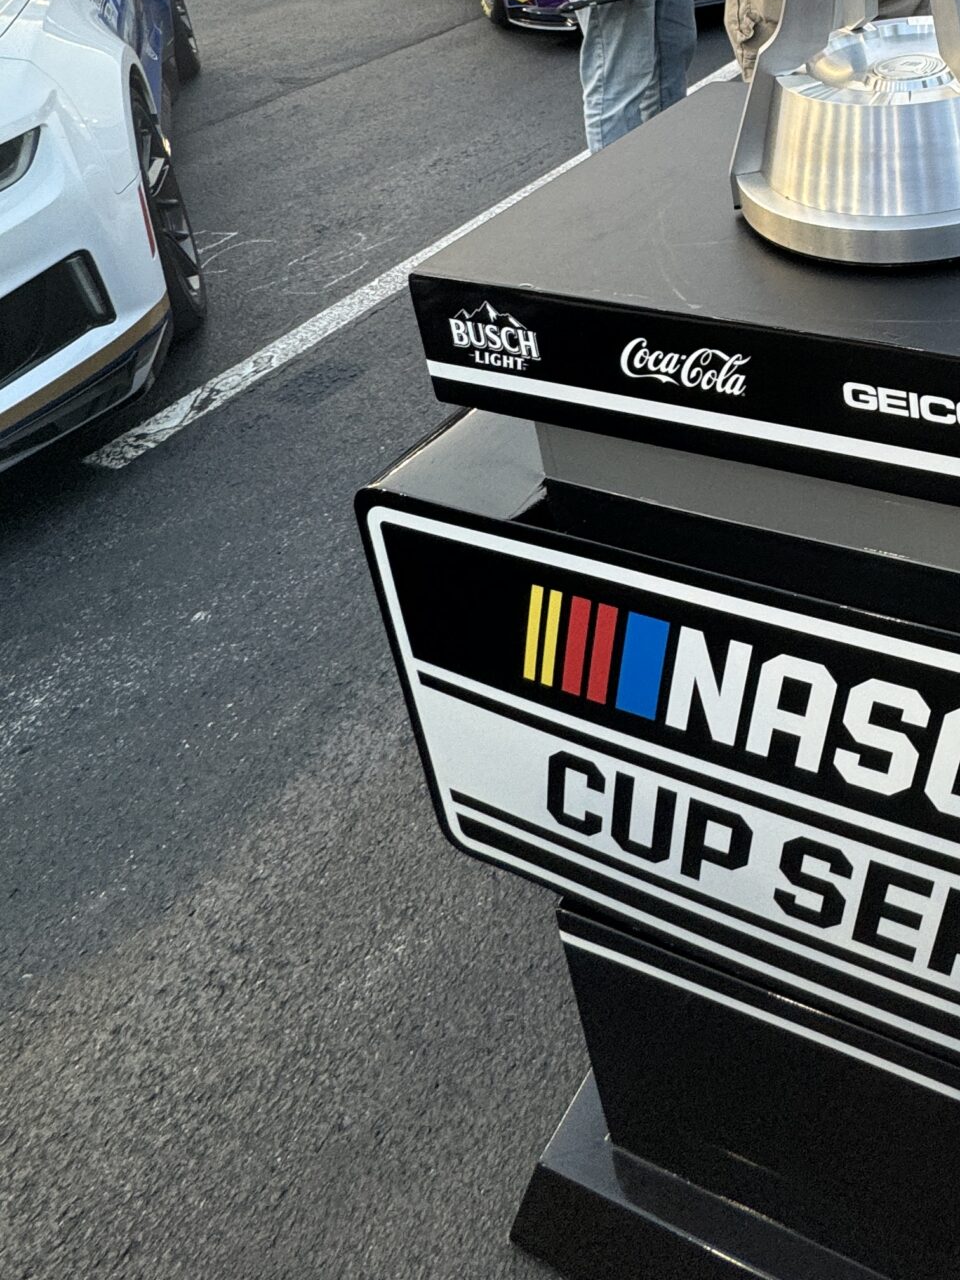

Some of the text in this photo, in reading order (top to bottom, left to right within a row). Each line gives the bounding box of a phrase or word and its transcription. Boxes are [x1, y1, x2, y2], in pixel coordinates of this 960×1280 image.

[449, 318, 541, 361] BUSCH
[474, 350, 525, 370] LIGHT
[620, 337, 751, 396] Coca-Cola
[547, 750, 754, 880] CUP
